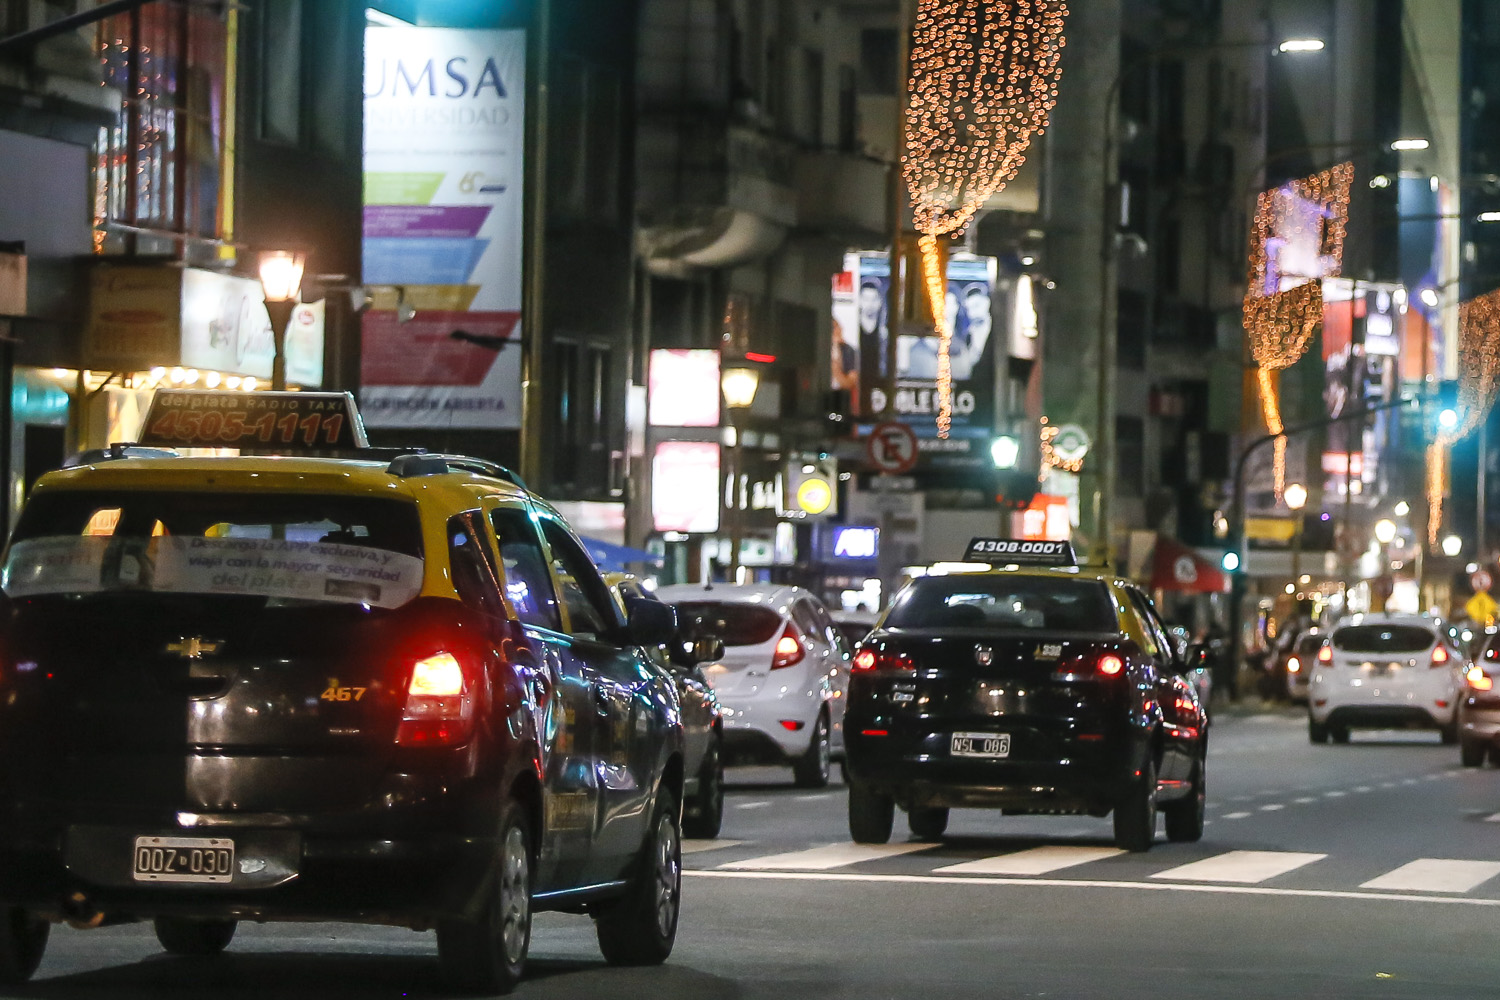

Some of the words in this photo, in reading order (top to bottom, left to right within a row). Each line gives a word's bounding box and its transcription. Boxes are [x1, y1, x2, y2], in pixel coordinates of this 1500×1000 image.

[245, 400, 299, 410] RADIO
[309, 401, 343, 410] TAXI
[152, 409, 344, 444] 4505-1111
[225, 557, 252, 568] con
[257, 556, 270, 569] la
[272, 560, 322, 573] mayor
[326, 563, 401, 582] seguridad
[321, 687, 367, 702] 467
